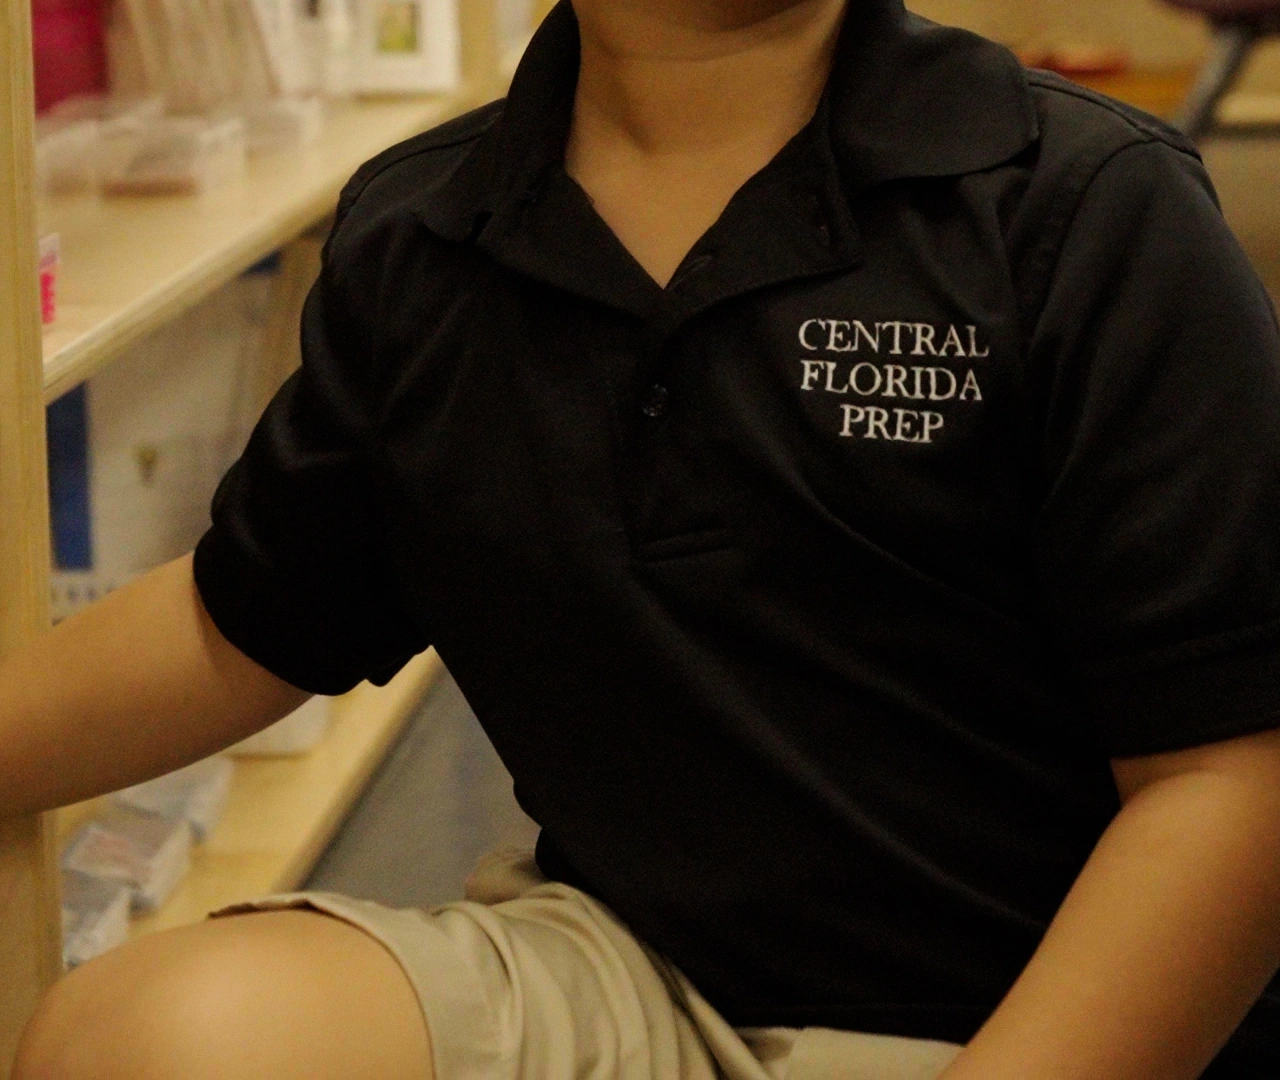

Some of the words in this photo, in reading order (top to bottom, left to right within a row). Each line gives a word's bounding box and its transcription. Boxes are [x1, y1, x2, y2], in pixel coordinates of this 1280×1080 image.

[799, 319, 989, 357] CENTRAL
[800, 360, 983, 401] FLORIDA
[839, 404, 944, 443] PREP
